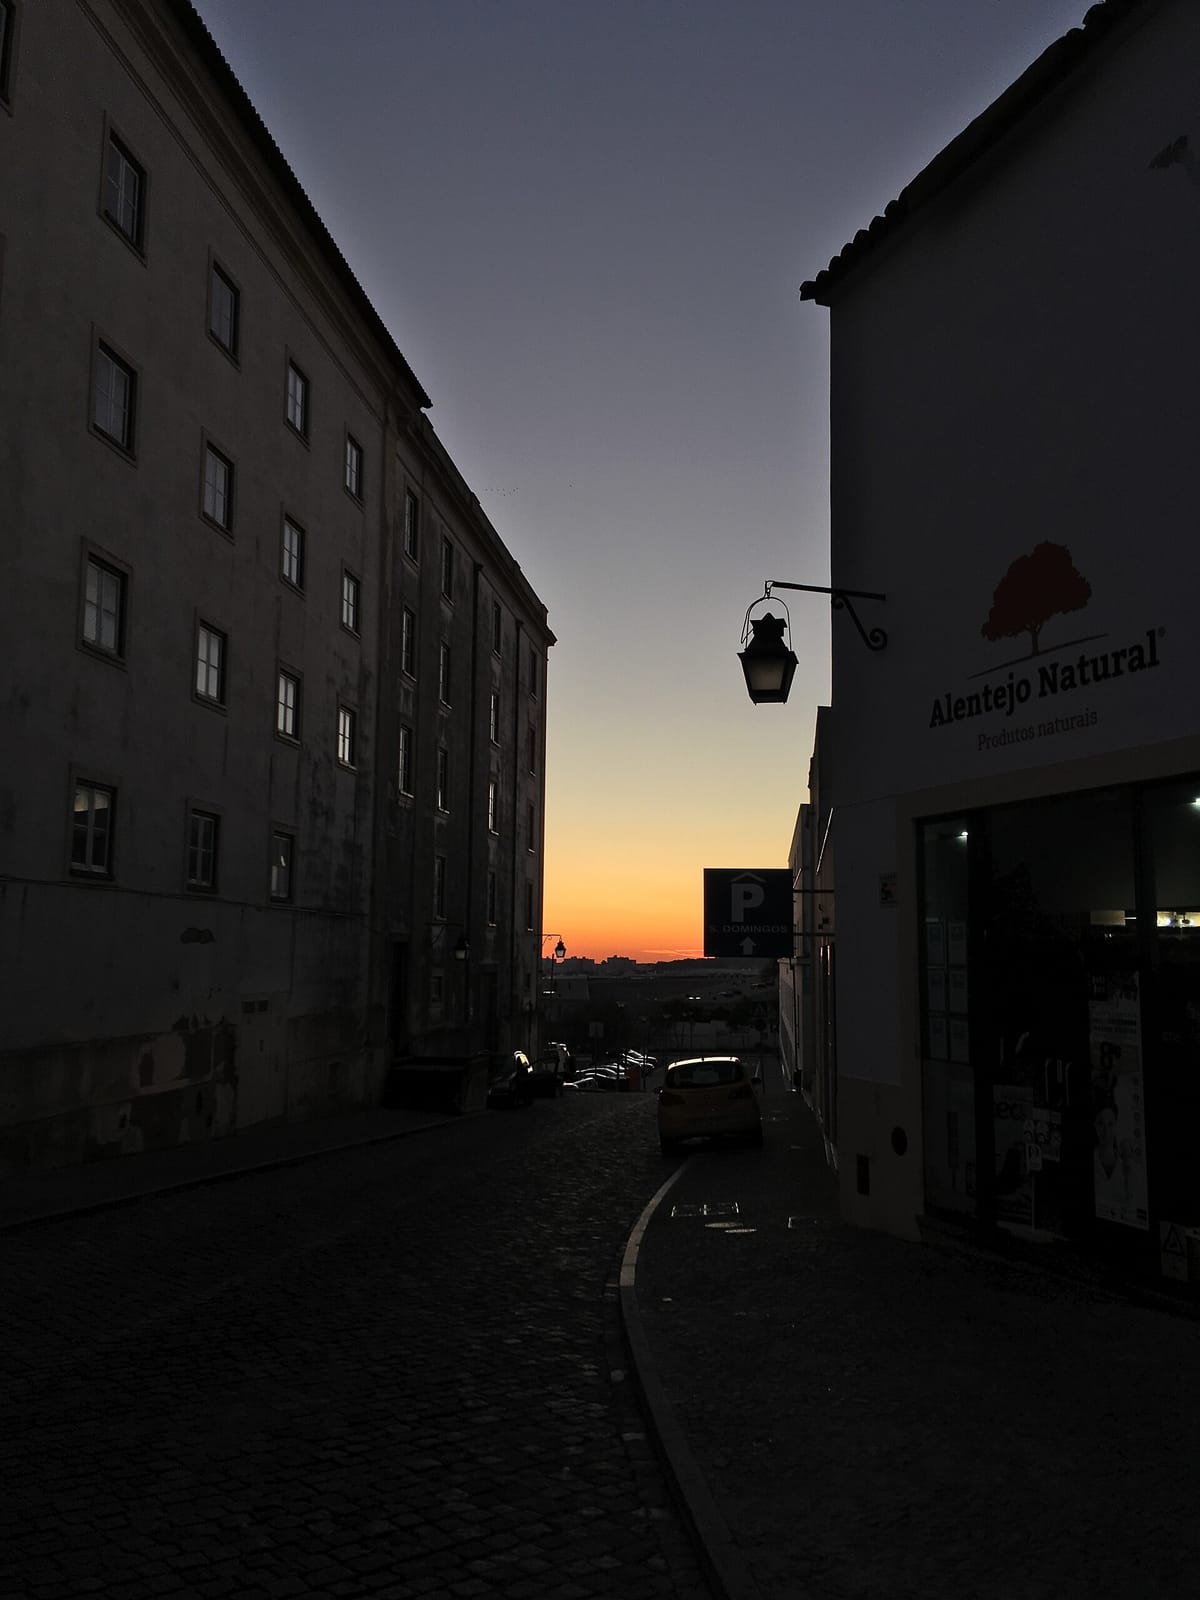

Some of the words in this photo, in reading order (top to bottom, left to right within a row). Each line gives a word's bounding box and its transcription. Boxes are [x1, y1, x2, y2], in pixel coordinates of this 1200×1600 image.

[929, 672, 1031, 728] Alentejo
[1038, 629, 1160, 698] Natural
[977, 724, 1035, 751] Produtos
[1037, 707, 1098, 738] naturais
[731, 883, 765, 922] P
[722, 924, 788, 934] DOMINGOS
